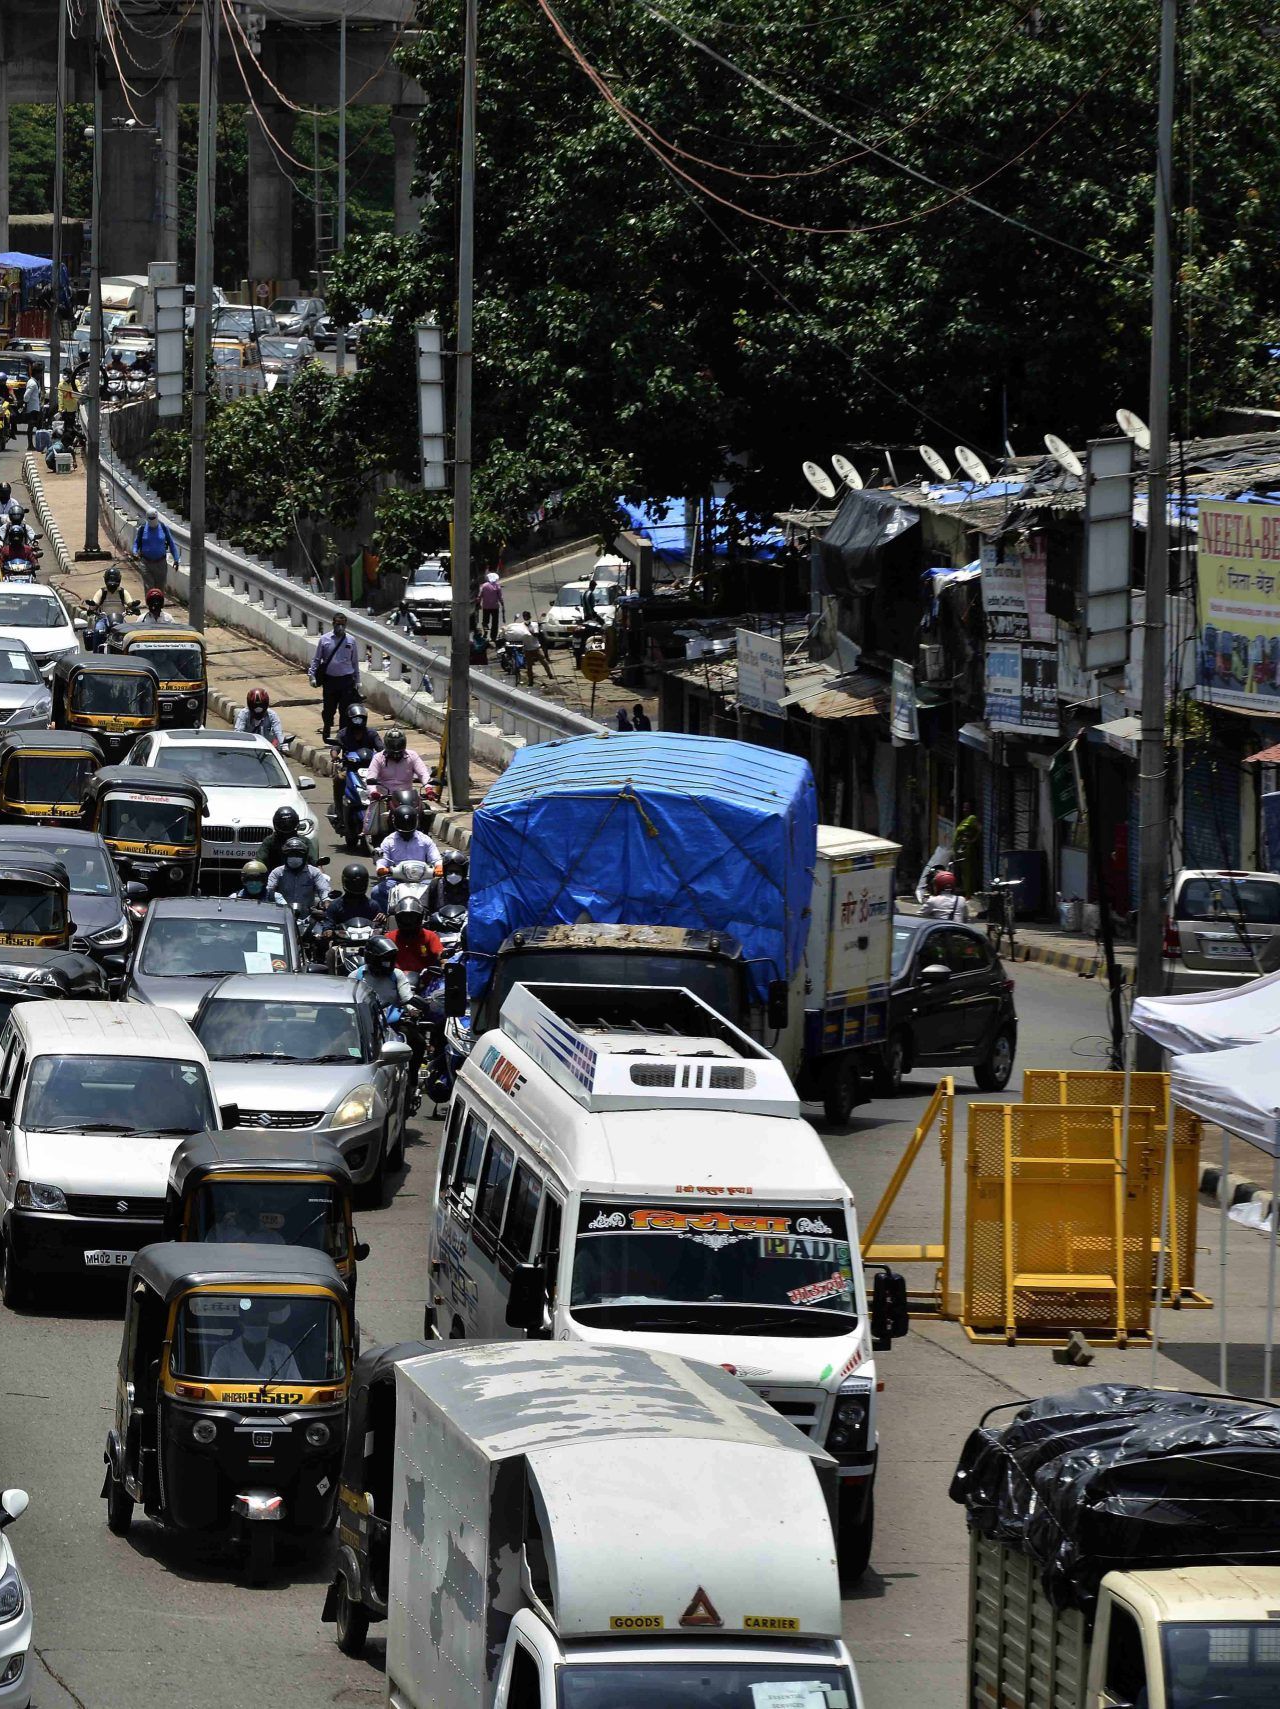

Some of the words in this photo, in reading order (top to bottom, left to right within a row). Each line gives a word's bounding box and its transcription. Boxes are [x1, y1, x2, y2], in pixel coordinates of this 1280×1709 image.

[86, 1254, 111, 1264] MH02
[115, 1255, 128, 1264] EP
[247, 1392, 303, 1405] 9582
[614, 1617, 661, 1628] GOODS
[744, 1617, 800, 1630] CARRIER
